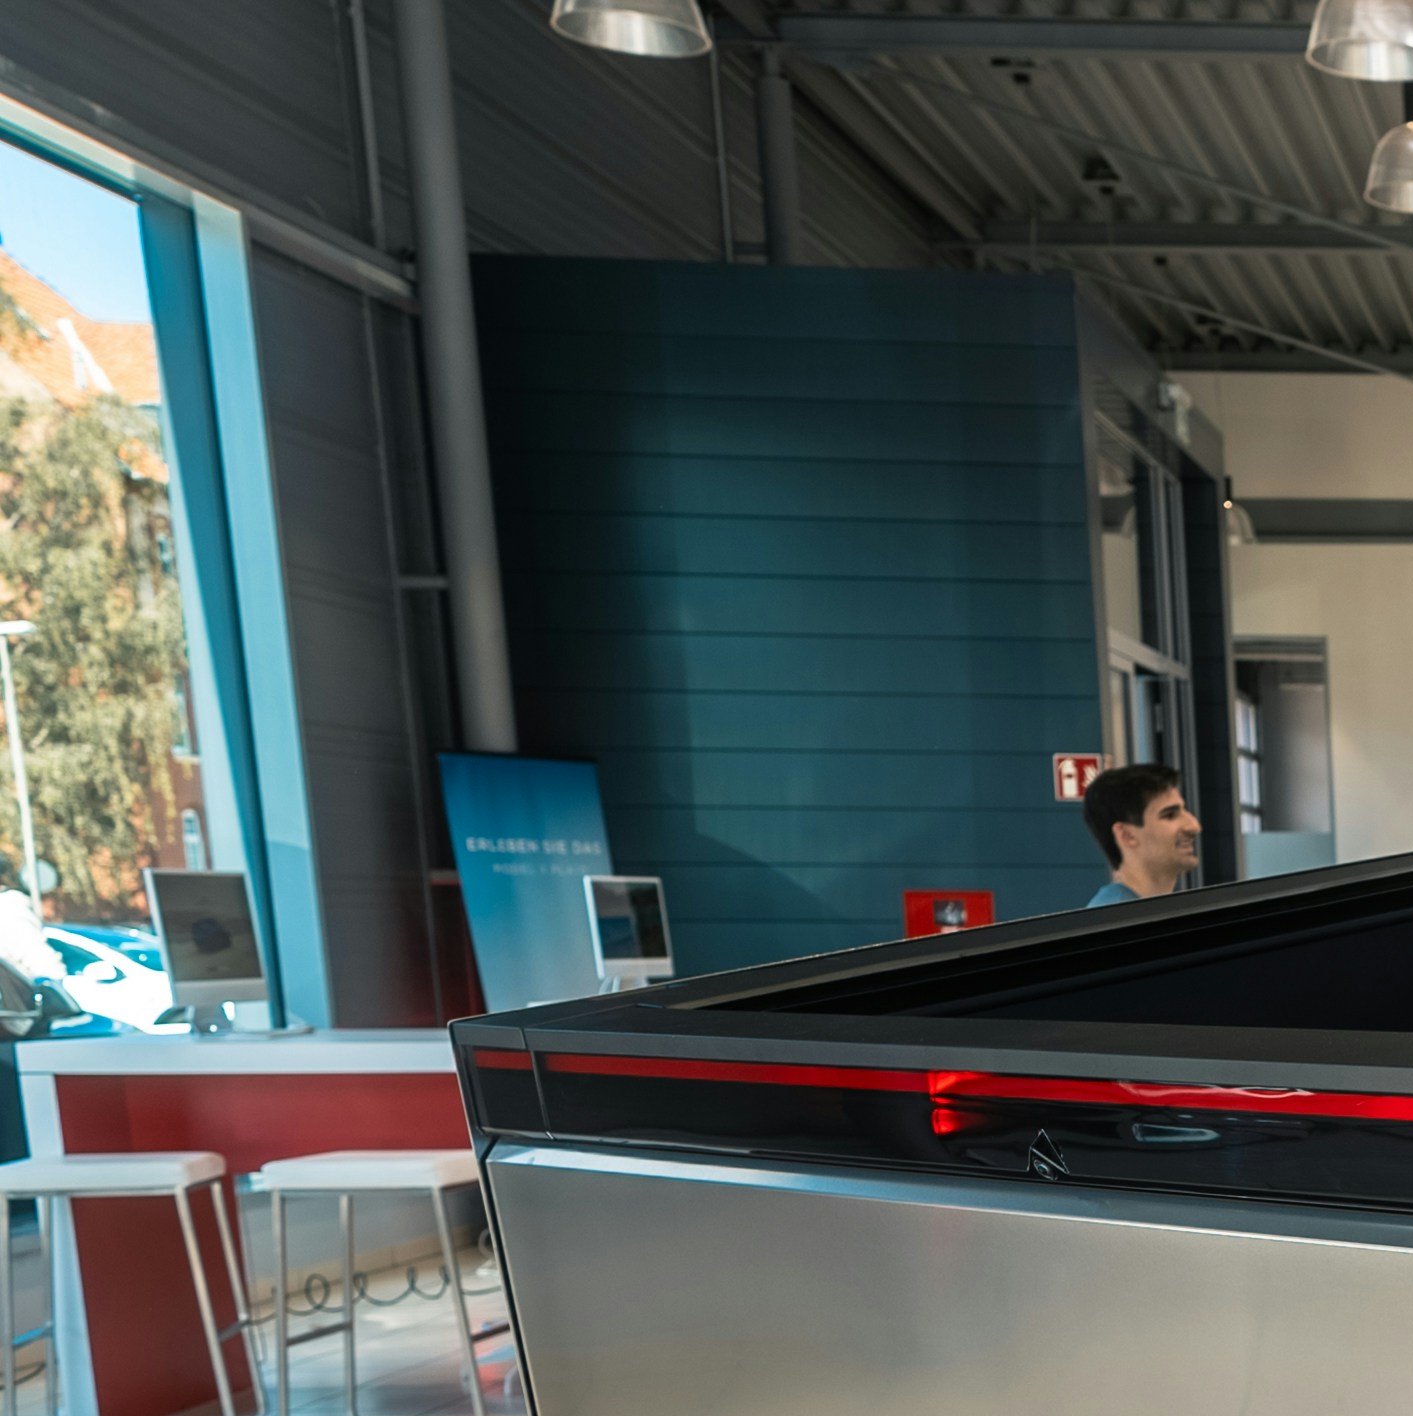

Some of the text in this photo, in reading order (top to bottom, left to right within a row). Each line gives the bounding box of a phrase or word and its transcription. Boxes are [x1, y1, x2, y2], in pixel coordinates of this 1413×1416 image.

[465, 837, 602, 856] ERLEBEN SIE DAS
